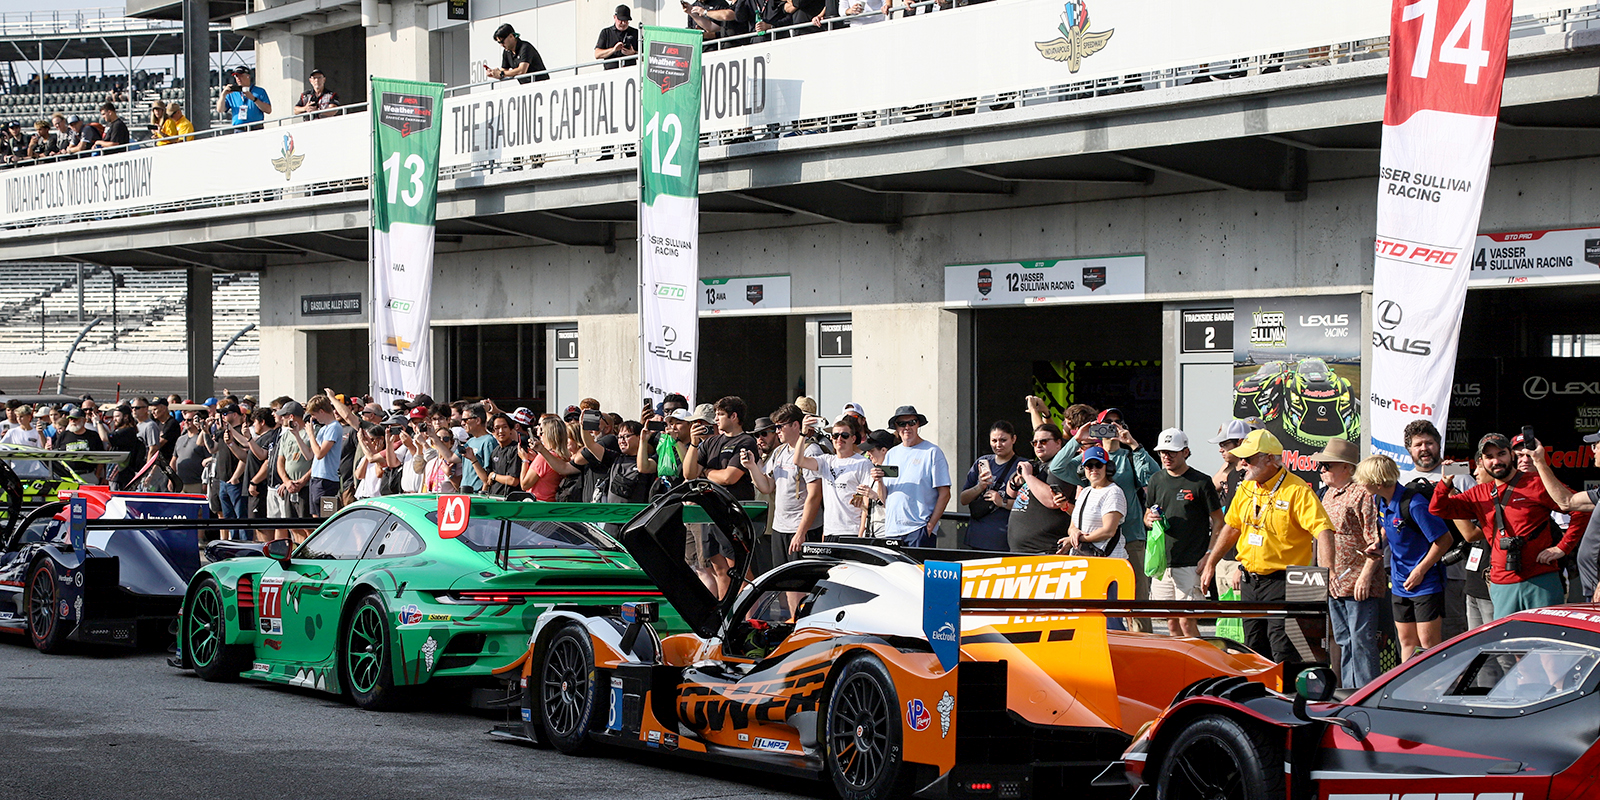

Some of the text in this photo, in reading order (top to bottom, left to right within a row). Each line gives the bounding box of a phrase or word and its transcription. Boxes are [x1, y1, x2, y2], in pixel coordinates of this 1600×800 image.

[1401, 0, 1490, 85] 14
[383, 104, 431, 117] WeatherTech
[452, 104, 480, 155] THE
[486, 92, 544, 149] RACING
[550, 82, 619, 142] CAPITAL
[625, 77, 636, 132] O
[645, 111, 682, 177] 12
[382, 151, 425, 208] 13
[1381, 166, 1411, 184] SSER
[6, 156, 153, 214] INDIANAPOLIS MOTOR SPEEDWAY
[1387, 182, 1442, 203] RACING
[1408, 246, 1458, 265] PRO
[1490, 247, 1526, 259] VASSER
[1490, 256, 1573, 270] SULLIVAN RACING
[1005, 272, 1044, 292] 12 VASSER
[1020, 280, 1075, 292] SULLIVAN RACING
[657, 286, 685, 298] GTD
[705, 288, 715, 305] 13
[310, 299, 359, 310] GASOLINE ALLEY SUITES
[391, 300, 410, 311] GTD
[1184, 312, 1234, 322] TRACKSIDE GARAGE
[1253, 313, 1283, 327] VASSER
[1300, 314, 1349, 327] LEXUS
[1204, 326, 1215, 348] 2
[1250, 326, 1287, 341] SULLIVAN
[836, 336, 842, 354] 1
[1373, 331, 1431, 356] EXUS
[1453, 383, 1480, 395] XUS
[933, 569, 958, 580] SKOPA
[962, 559, 1089, 600] TOWER
[261, 586, 279, 616] 77
[401, 604, 418, 625] VP
[678, 660, 827, 732] OWER
[578, 691, 595, 735] MICHELIN
[609, 689, 616, 727] 8
[908, 699, 924, 730] VP
[761, 739, 786, 750] LMP2
